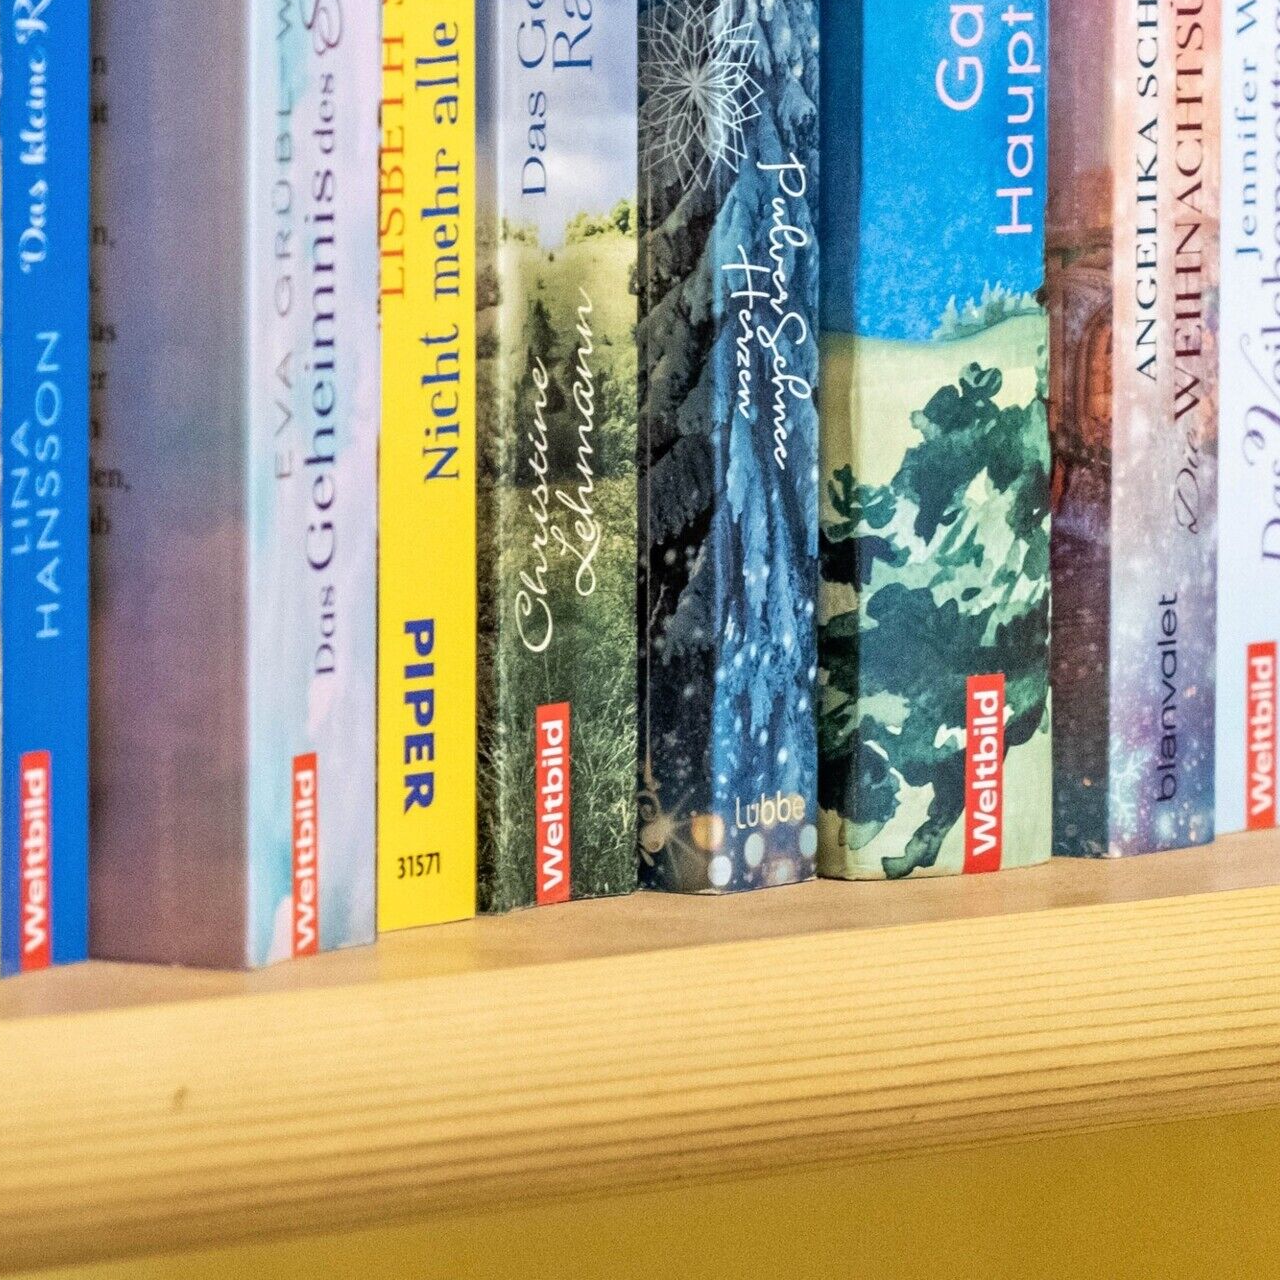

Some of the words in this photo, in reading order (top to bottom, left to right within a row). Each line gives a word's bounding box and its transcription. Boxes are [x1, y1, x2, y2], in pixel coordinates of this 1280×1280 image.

[19, 54, 49, 168] kleine
[314, 71, 336, 156] des
[415, 20, 460, 126] alle
[521, 89, 548, 197] Das
[18, 177, 49, 276] Das
[379, 36, 407, 302] LISBETH
[420, 147, 460, 299] mehr
[1235, 56, 1261, 261] Jennifer
[720, 243, 772, 420] Herzen
[1135, 119, 1160, 382] ANGELIKA
[273, 349, 293, 480] EVA
[304, 167, 336, 572] Geheimnis
[421, 322, 460, 484] Nicht
[556, 285, 595, 598] Lehmann
[10, 420, 30, 557] LINA
[35, 330, 62, 638] HANSSON
[515, 354, 551, 654] Christine
[1173, 426, 1202, 536] Die
[314, 586, 337, 675] Das
[1156, 592, 1179, 803] blanvalet
[402, 617, 436, 815] PIPER
[972, 689, 1000, 858] Weltbild
[1249, 655, 1276, 816] Weltbild
[22, 765, 50, 955] Weltbild
[292, 767, 317, 952] Weltbild
[396, 851, 442, 880] 31571
[541, 719, 565, 893] Weltbild
